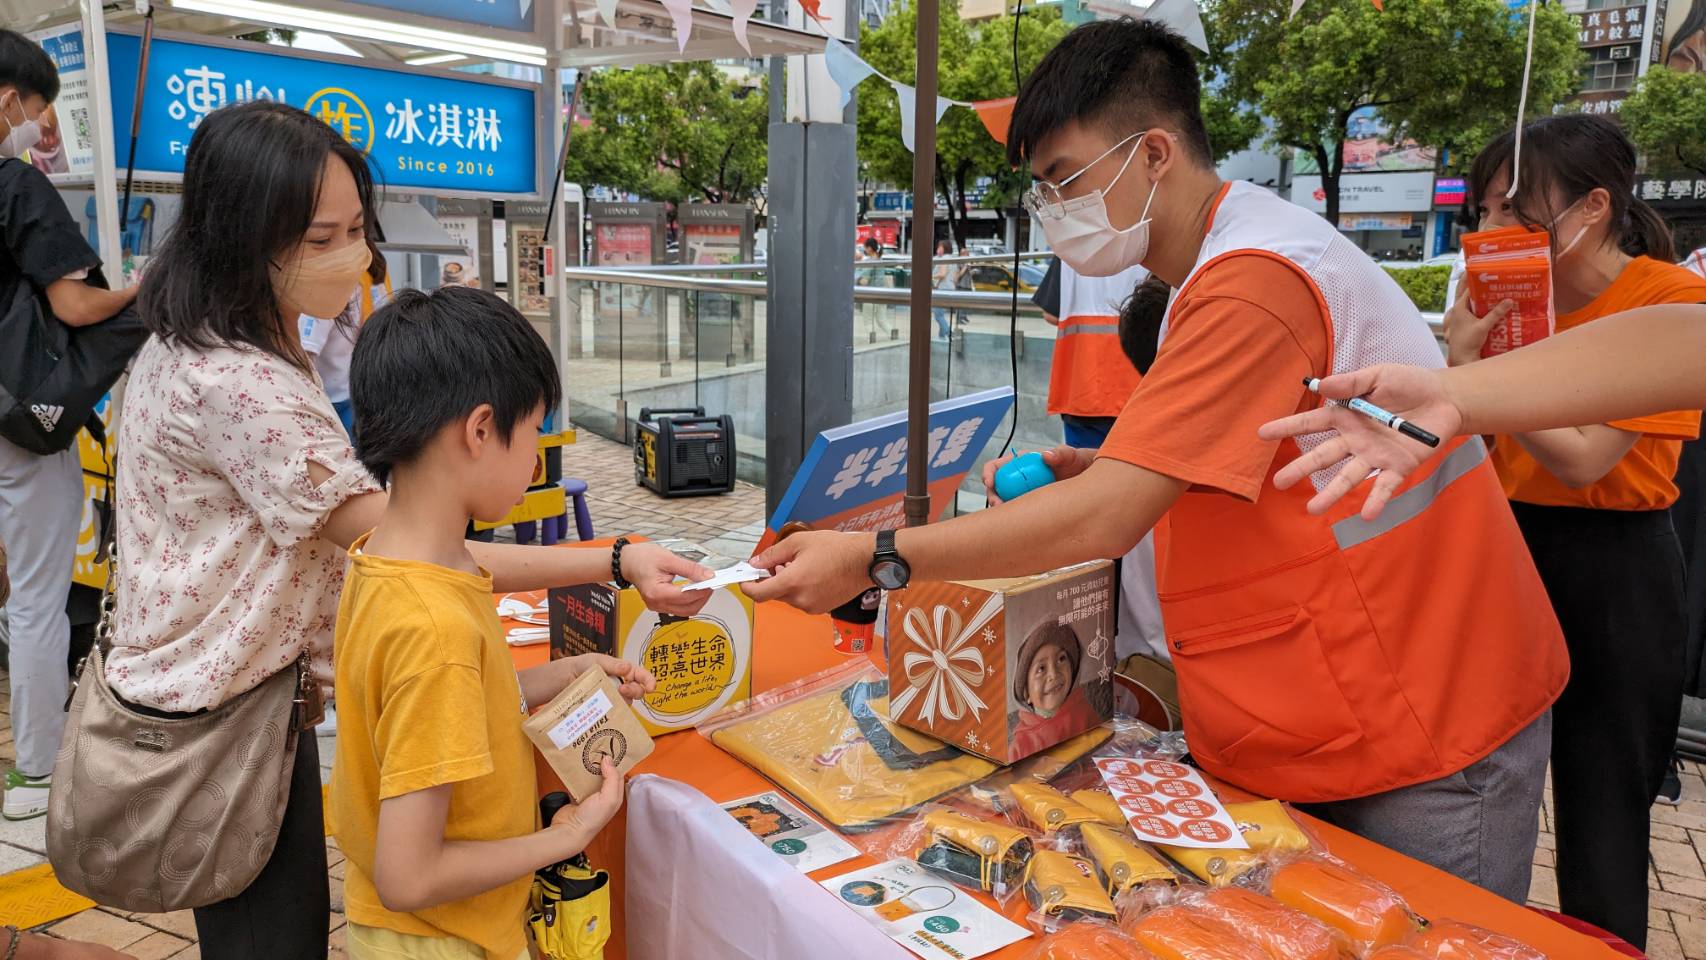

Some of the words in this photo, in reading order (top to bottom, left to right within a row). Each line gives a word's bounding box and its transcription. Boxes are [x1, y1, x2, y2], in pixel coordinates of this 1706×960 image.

[385, 99, 502, 152] 冰淇淋
[398, 156, 447, 173] Since
[456, 160, 494, 176] 2016
[650, 634, 727, 664] 轉變生命
